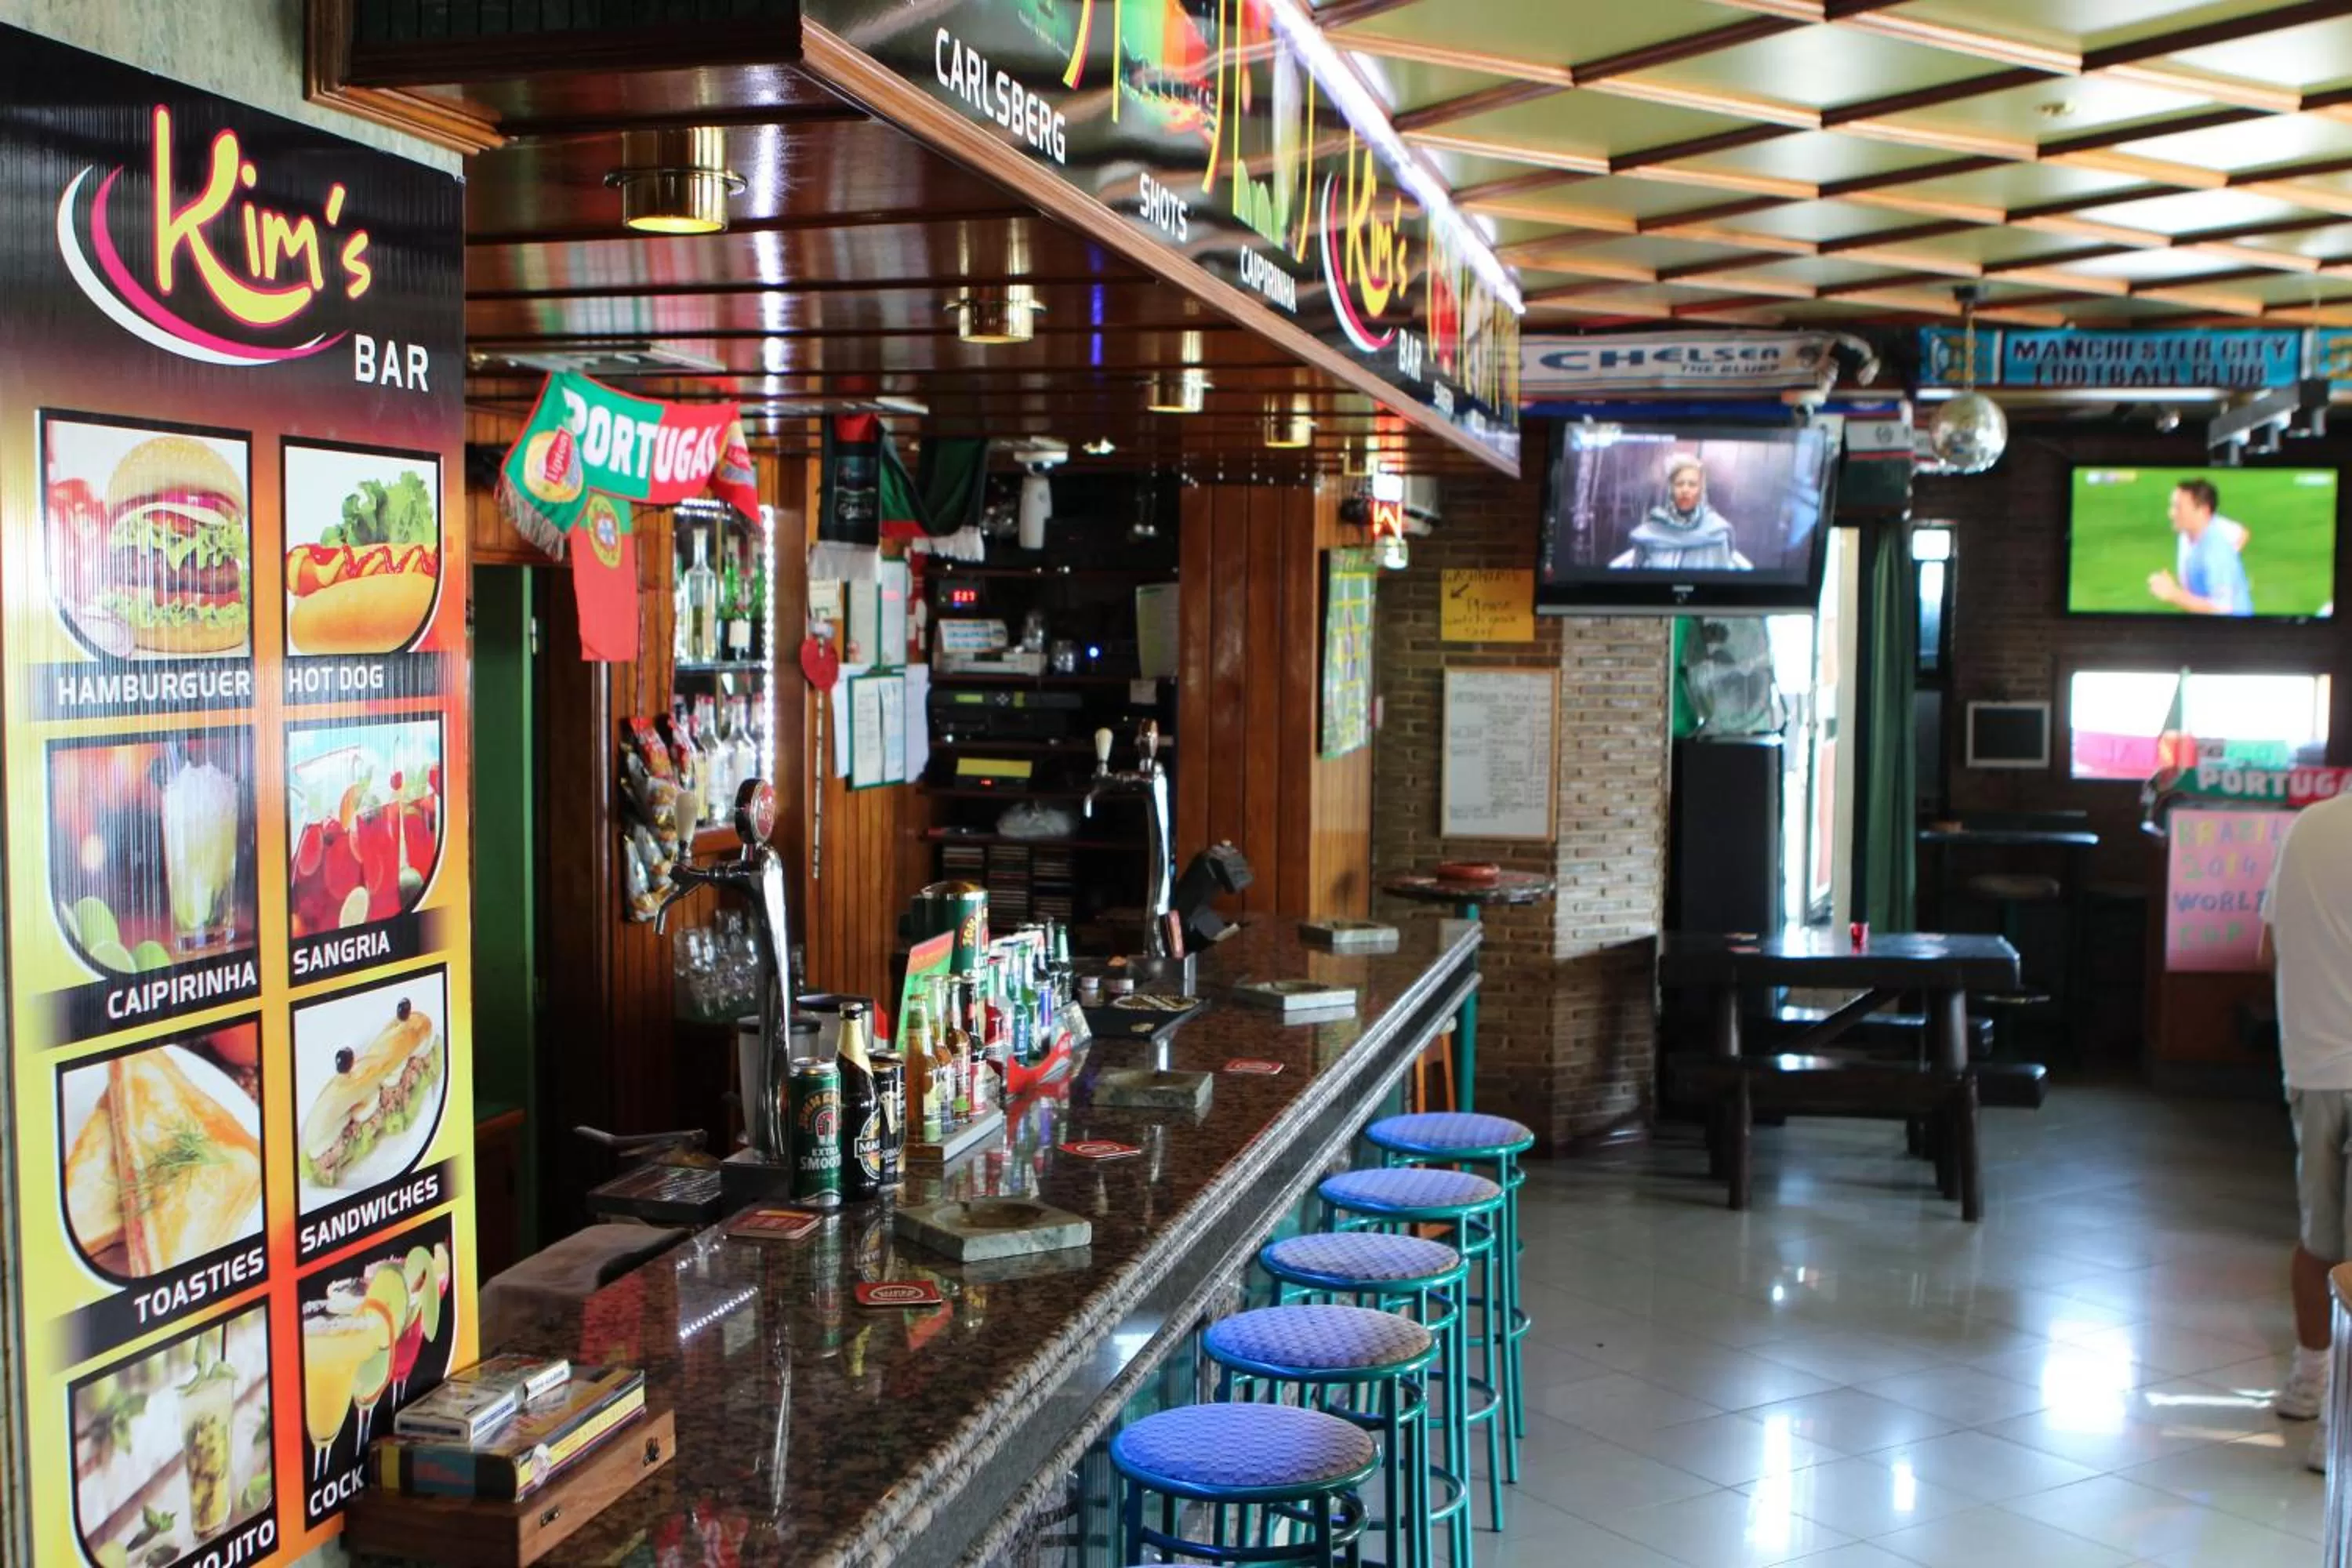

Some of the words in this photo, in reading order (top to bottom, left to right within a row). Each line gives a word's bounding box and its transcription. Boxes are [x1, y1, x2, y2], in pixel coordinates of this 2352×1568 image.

[935, 27, 1066, 165] CARLSBERG
[153, 103, 371, 326] Kim's
[1140, 172, 1188, 243] SHOTS
[1346, 128, 1407, 318] Kim's
[1240, 245, 1297, 314] CAIPIRINHA
[354, 334, 429, 392] BAR
[1399, 328, 1421, 383] BAR
[1539, 347, 1780, 372] CHELSEA
[2014, 339, 2212, 360] MANCHESTER
[2221, 338, 2288, 359] CITY
[2035, 363, 2179, 386] FOOTBALL
[2193, 363, 2266, 386] CLUB
[58, 669, 251, 706] HAMBURGUER
[289, 666, 333, 693] HOT
[339, 664, 384, 690] DOG
[293, 930, 390, 975] SANGRIA
[107, 963, 256, 1020] CAIPIRINHA
[800, 1156, 841, 1171] SMOO
[301, 1174, 438, 1254] SANDWICHES
[134, 1247, 264, 1323] TOASTIES
[309, 1464, 365, 1516] COCK
[191, 1519, 274, 1568] OJITO
